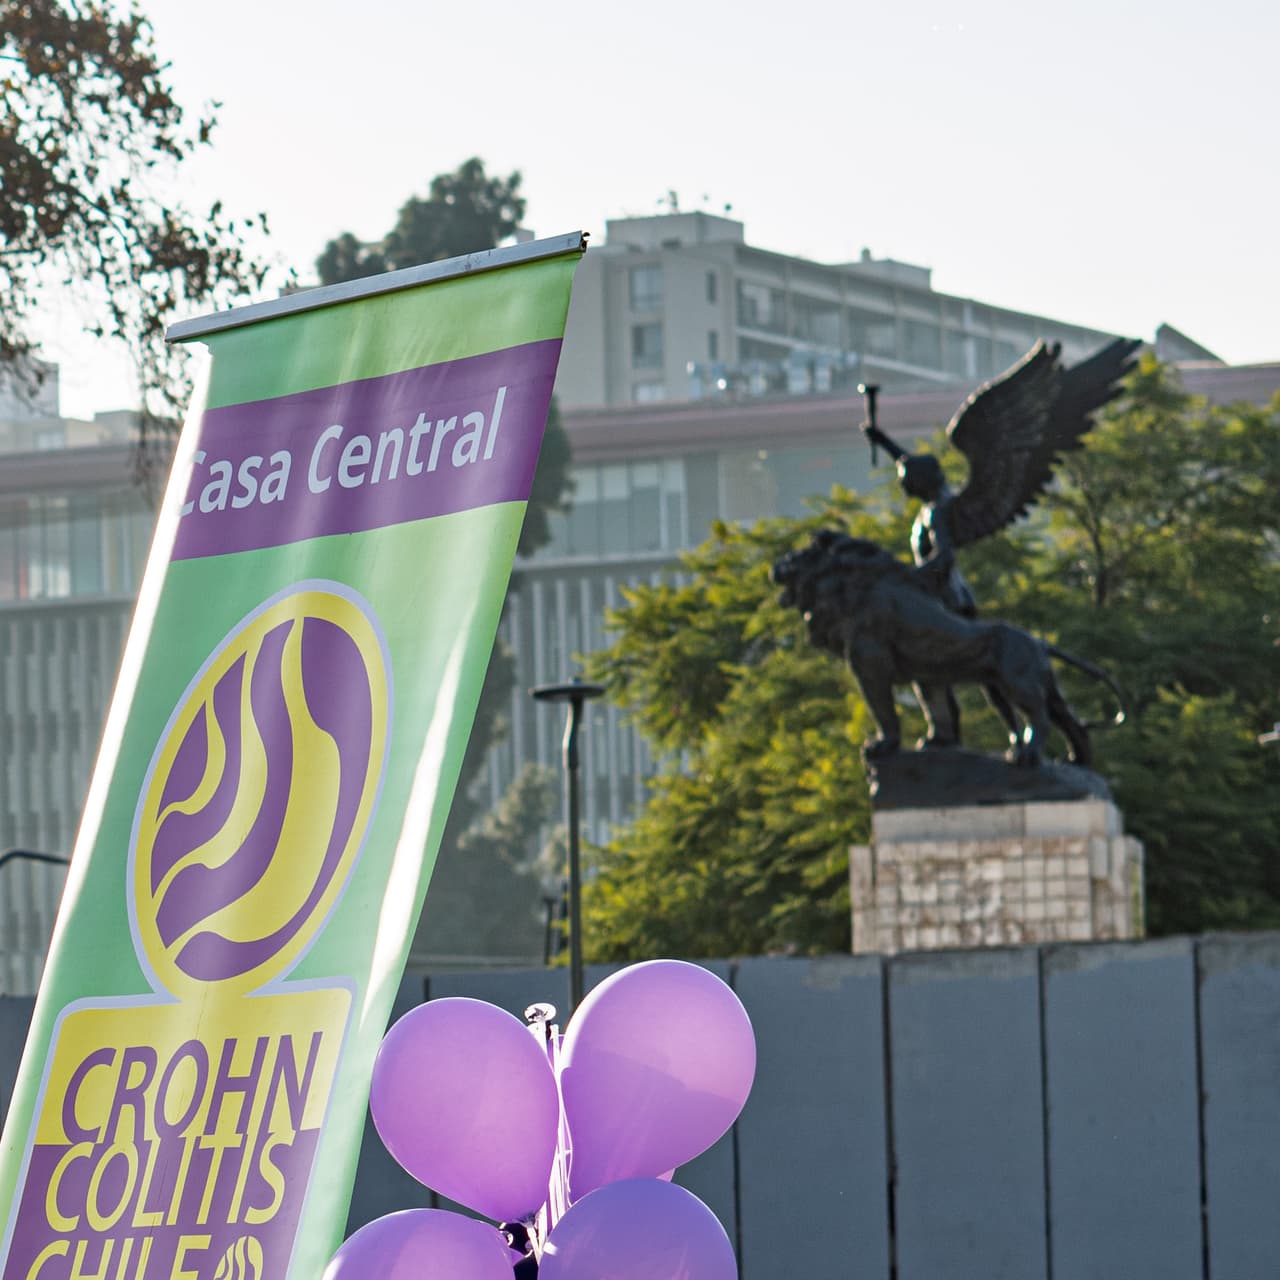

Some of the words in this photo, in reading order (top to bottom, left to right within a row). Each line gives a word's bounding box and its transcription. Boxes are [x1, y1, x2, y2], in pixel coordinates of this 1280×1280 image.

[307, 386, 507, 494] Central
[62, 1031, 323, 1145] CROHN
[45, 1129, 296, 1233] COLITIS
